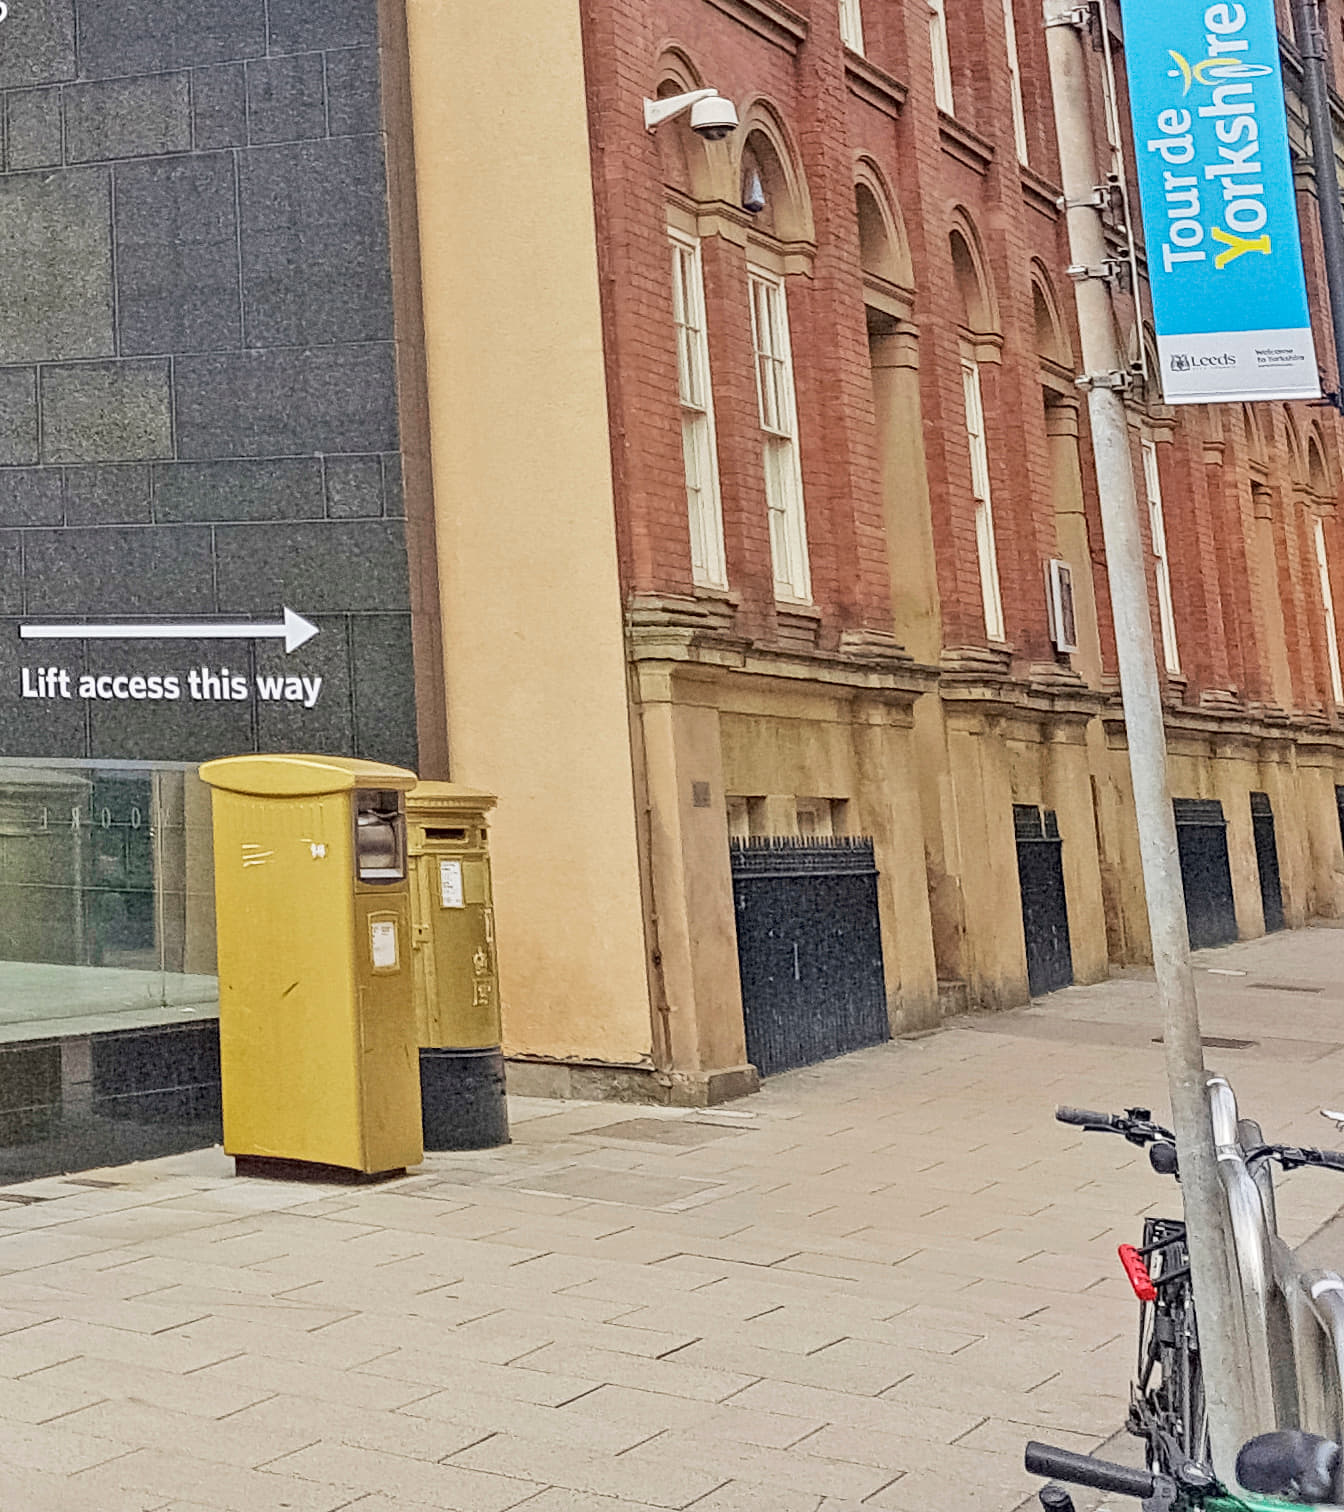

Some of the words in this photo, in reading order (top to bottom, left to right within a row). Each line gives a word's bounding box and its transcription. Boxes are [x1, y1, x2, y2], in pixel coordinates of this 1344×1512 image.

[1148, 108, 1196, 167] de
[1199, 1, 1273, 270] Yorkshire
[1162, 172, 1207, 272] Tour
[1192, 353, 1236, 367] Leeds
[21, 667, 71, 699] Lift
[79, 674, 180, 700] access
[187, 667, 248, 700] this
[256, 675, 322, 708] way
